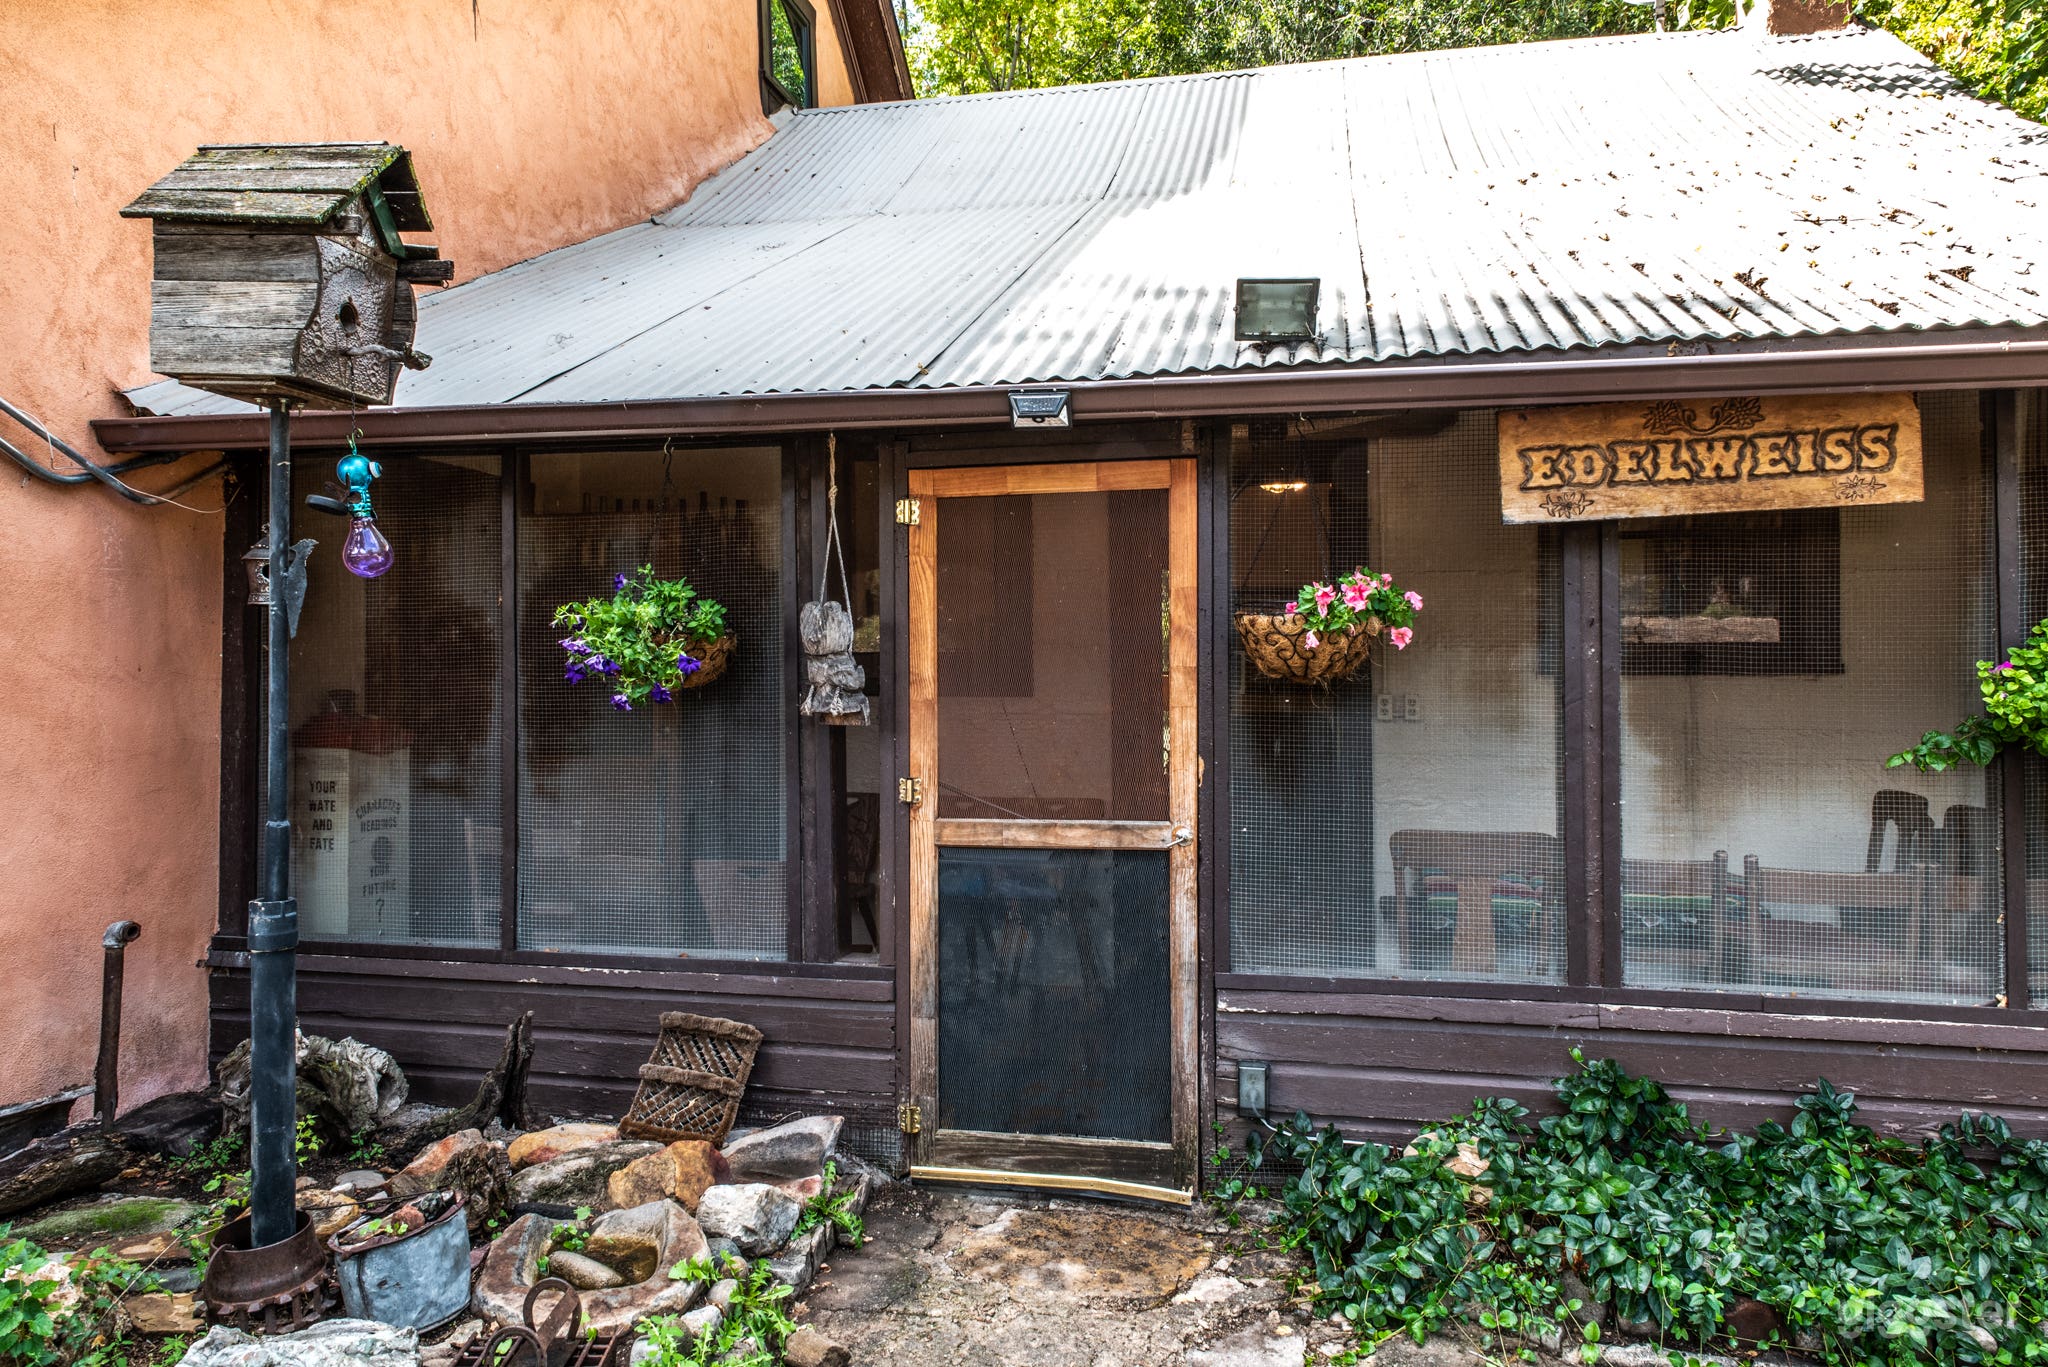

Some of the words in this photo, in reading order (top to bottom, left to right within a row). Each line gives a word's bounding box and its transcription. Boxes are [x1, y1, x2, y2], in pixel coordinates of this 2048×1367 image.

[1519, 424, 1899, 491] EDELWEISS
[309, 780, 336, 793] YOUR
[312, 818, 333, 831] AND
[309, 837, 334, 850] FATE
